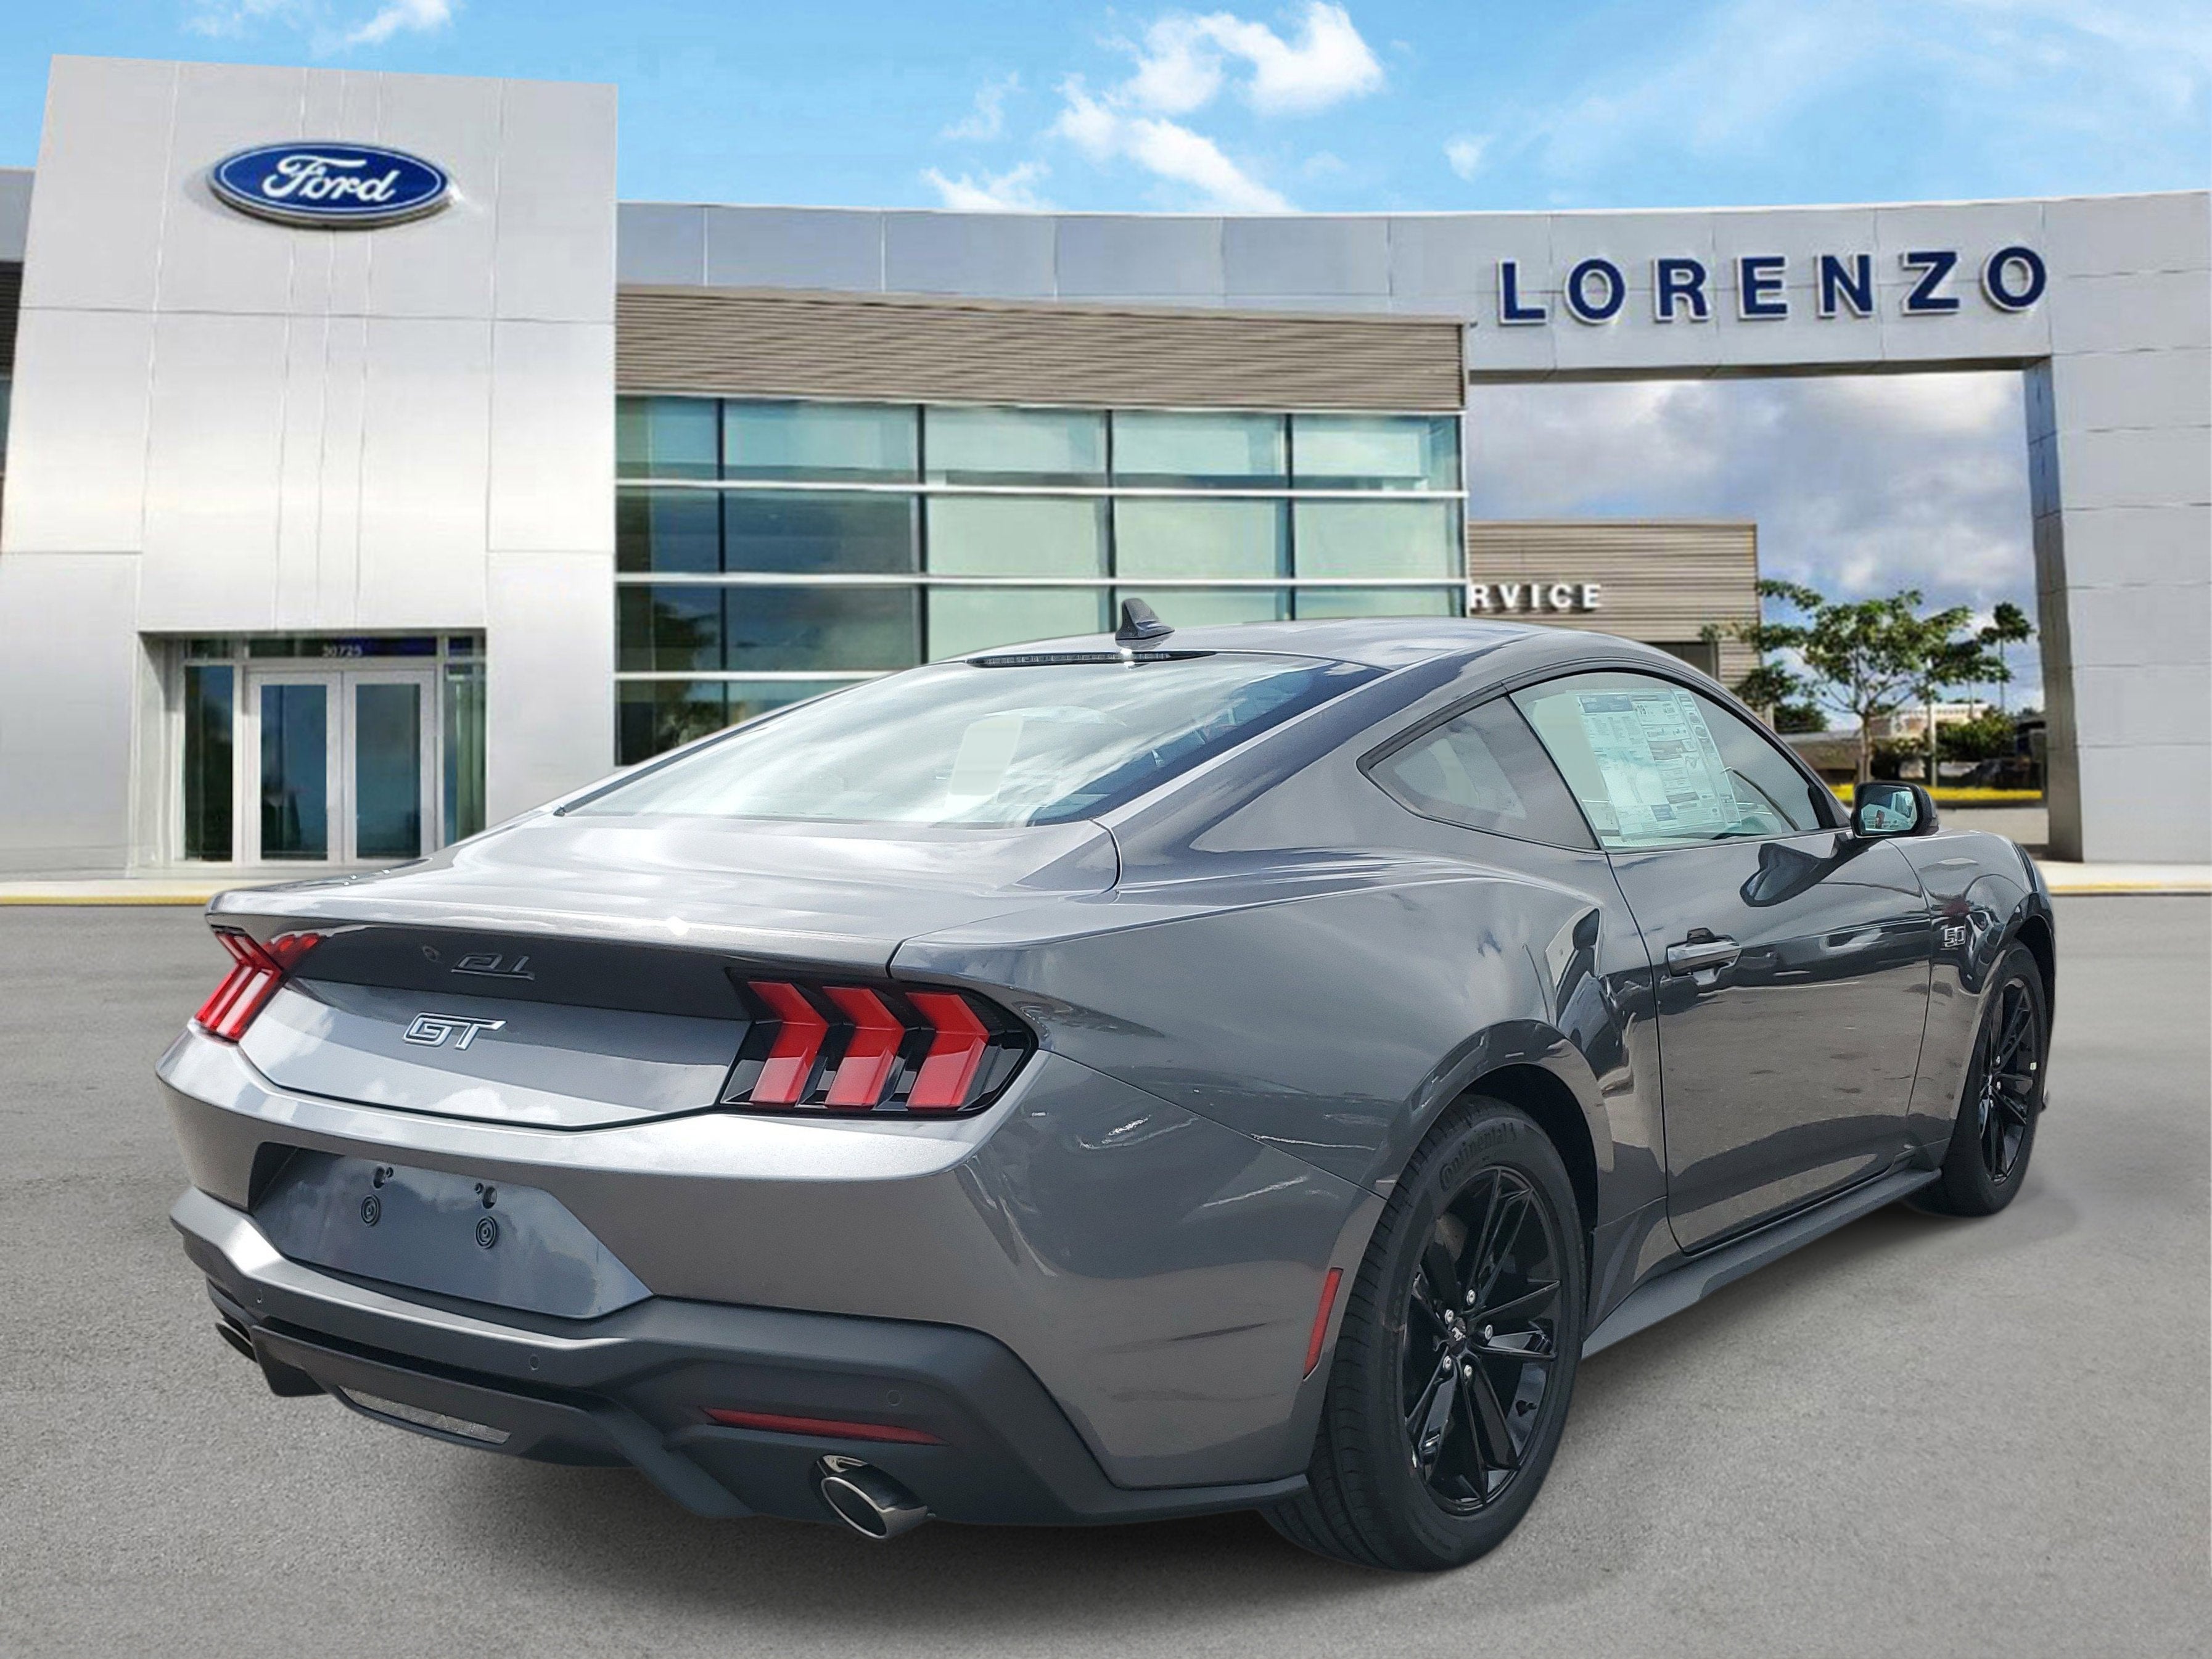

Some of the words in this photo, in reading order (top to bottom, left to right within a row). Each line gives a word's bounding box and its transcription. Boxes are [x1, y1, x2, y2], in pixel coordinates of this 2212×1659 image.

[261, 154, 400, 202] Ford
[1497, 245, 2047, 326] LORENZO
[1470, 583, 1603, 609] RVICE
[403, 1011, 507, 1050] GT
